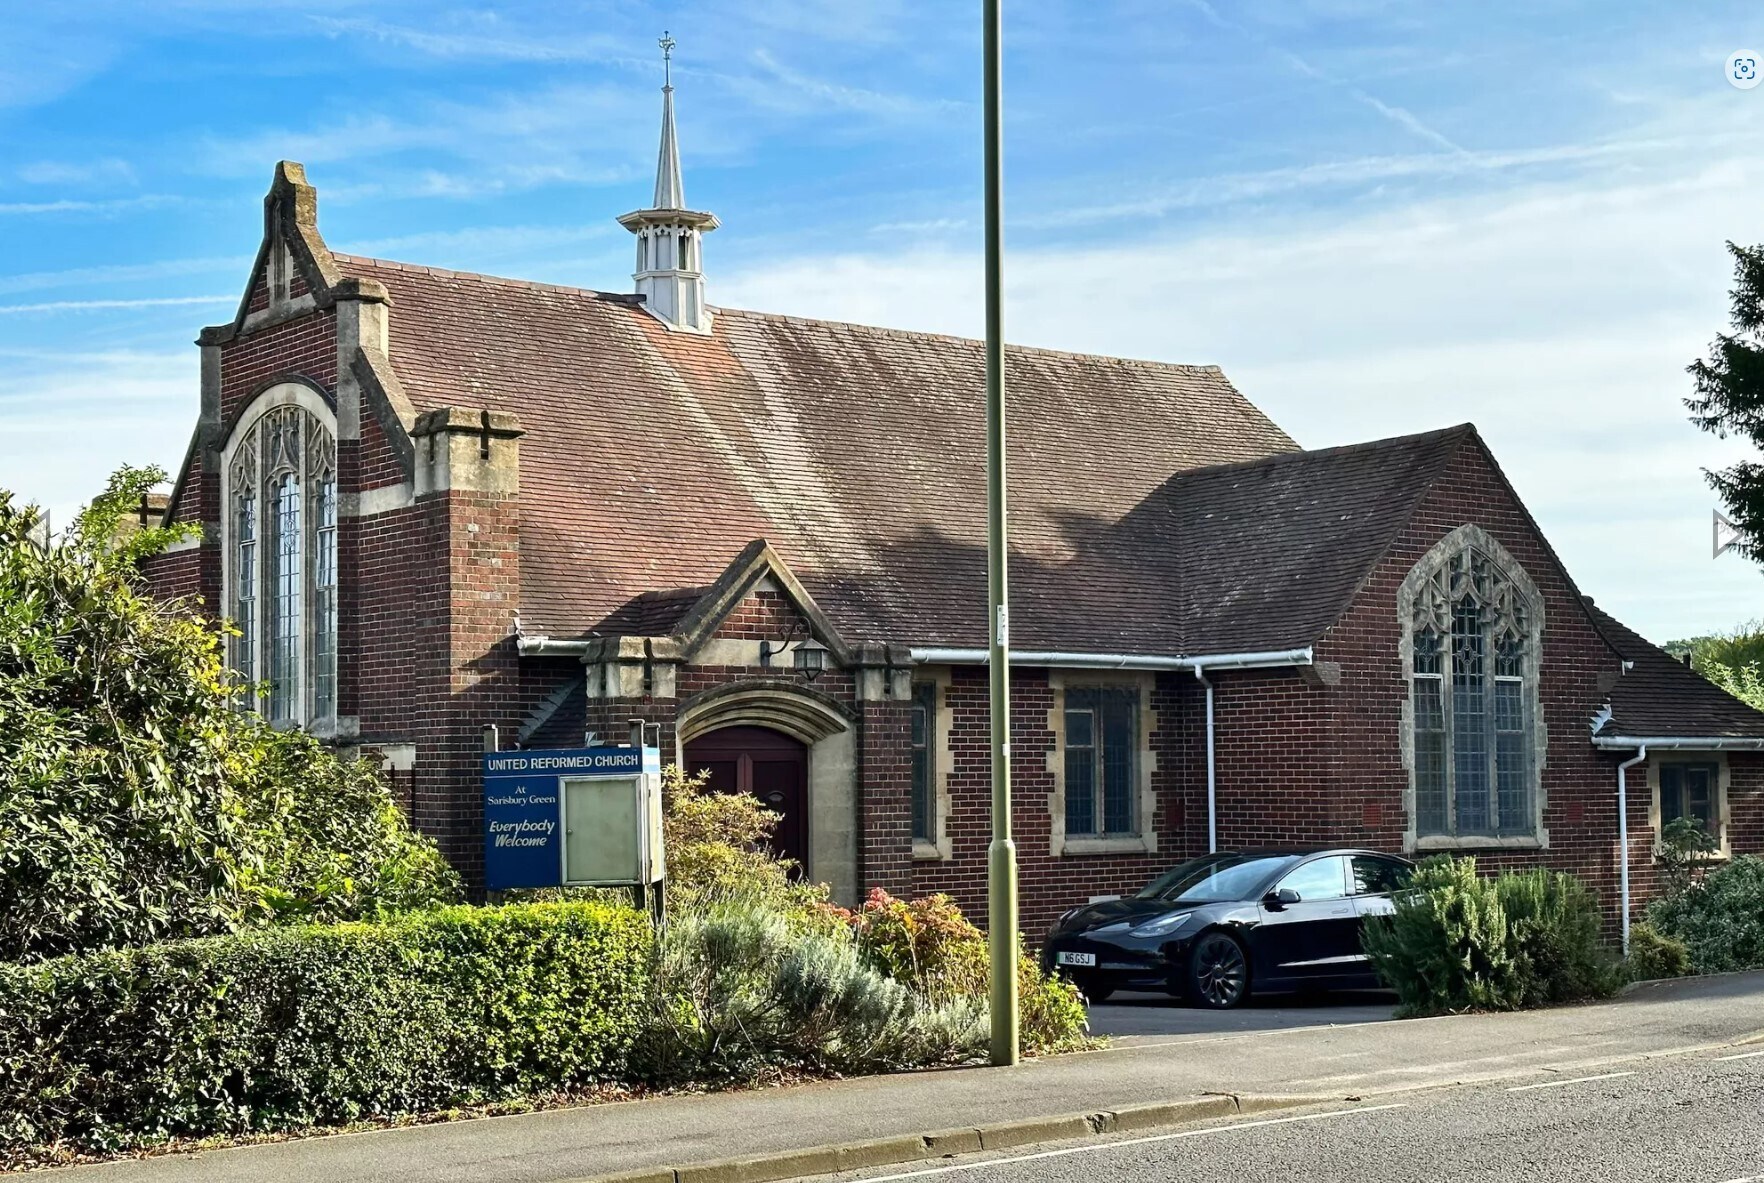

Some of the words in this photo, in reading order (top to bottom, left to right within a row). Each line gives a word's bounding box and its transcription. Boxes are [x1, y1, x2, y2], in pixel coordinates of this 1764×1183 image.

[488, 758, 528, 771] UNITED
[530, 756, 592, 769] REFORMED
[595, 755, 638, 767] CHURCH
[515, 785, 526, 794] At
[487, 795, 528, 807] Sarisbury
[529, 794, 556, 804] Green
[489, 819, 555, 835] Everybody
[495, 833, 547, 847] Welcome
